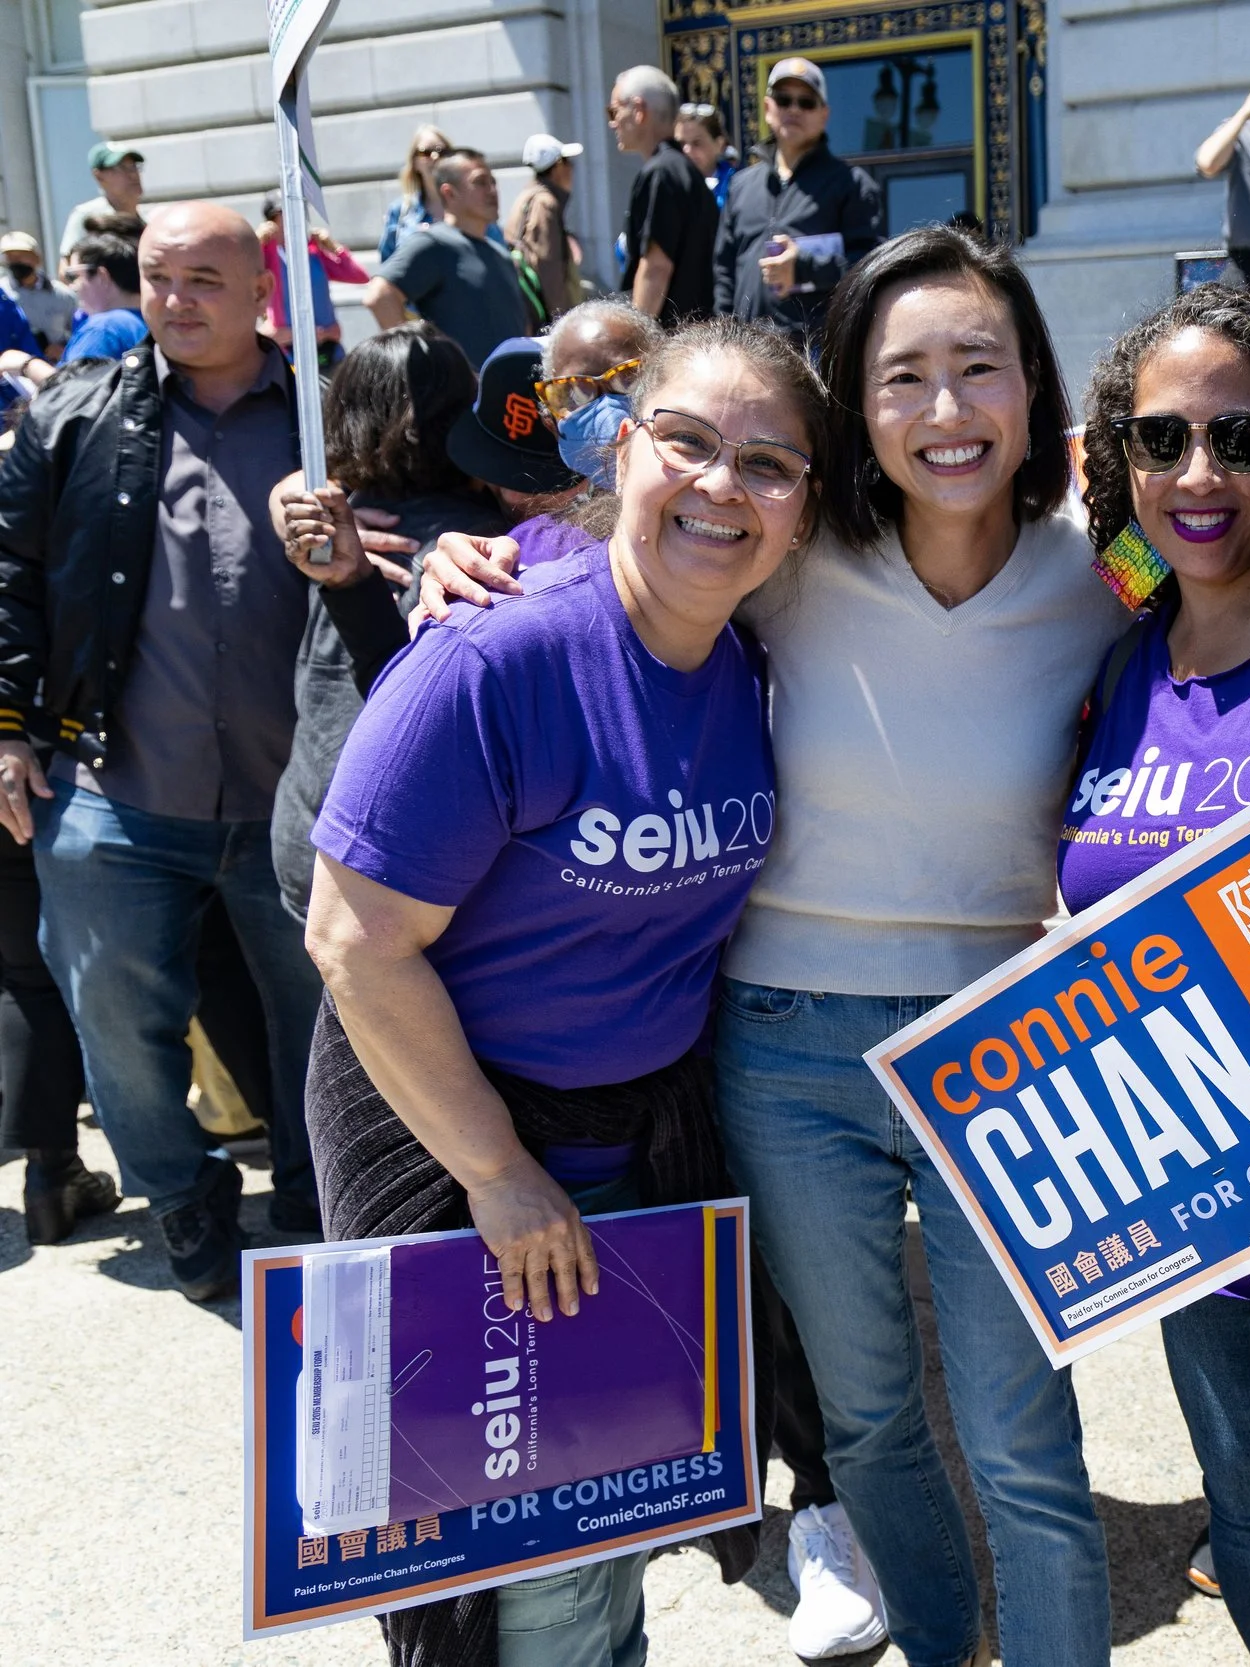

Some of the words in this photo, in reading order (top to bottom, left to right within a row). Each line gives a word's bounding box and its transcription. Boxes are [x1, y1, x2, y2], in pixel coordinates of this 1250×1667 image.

[503, 392, 539, 440] SF
[1072, 746, 1193, 818] seiu
[570, 788, 719, 873] seiu
[1128, 828, 1170, 848] Long
[560, 869, 673, 896] California's
[675, 871, 707, 888] Long
[712, 863, 741, 879] Term
[931, 934, 1190, 1114] connie
[1170, 1180, 1243, 1232] FOR
[1044, 1219, 1162, 1298] 國會議員
[1067, 1306, 1084, 1321] Paid
[1083, 1301, 1094, 1314] for
[1094, 1299, 1104, 1309] by
[1103, 1287, 1128, 1304] Connie
[1128, 1277, 1148, 1290] Chan
[1147, 1271, 1159, 1283] for
[1158, 1253, 1195, 1276] Congress
[526, 1322, 536, 1355] Term
[527, 1358, 539, 1391] Long
[312, 1421, 320, 1435] SEIU
[471, 1356, 521, 1480] seiu
[527, 1395, 538, 1471] California's
[312, 1501, 321, 1520] seiu
[471, 1492, 541, 1530] FOR
[552, 1451, 723, 1511] CONGRESS
[577, 1488, 726, 1532] ConnieChanSF.com
[297, 1514, 443, 1569] 國會議員
[294, 1586, 316, 1597] Paid
[318, 1582, 332, 1592] for
[334, 1579, 347, 1590] by
[348, 1572, 383, 1586] Connie
[384, 1567, 408, 1579] Chan
[409, 1563, 423, 1573] for
[424, 1553, 466, 1570] Congress
